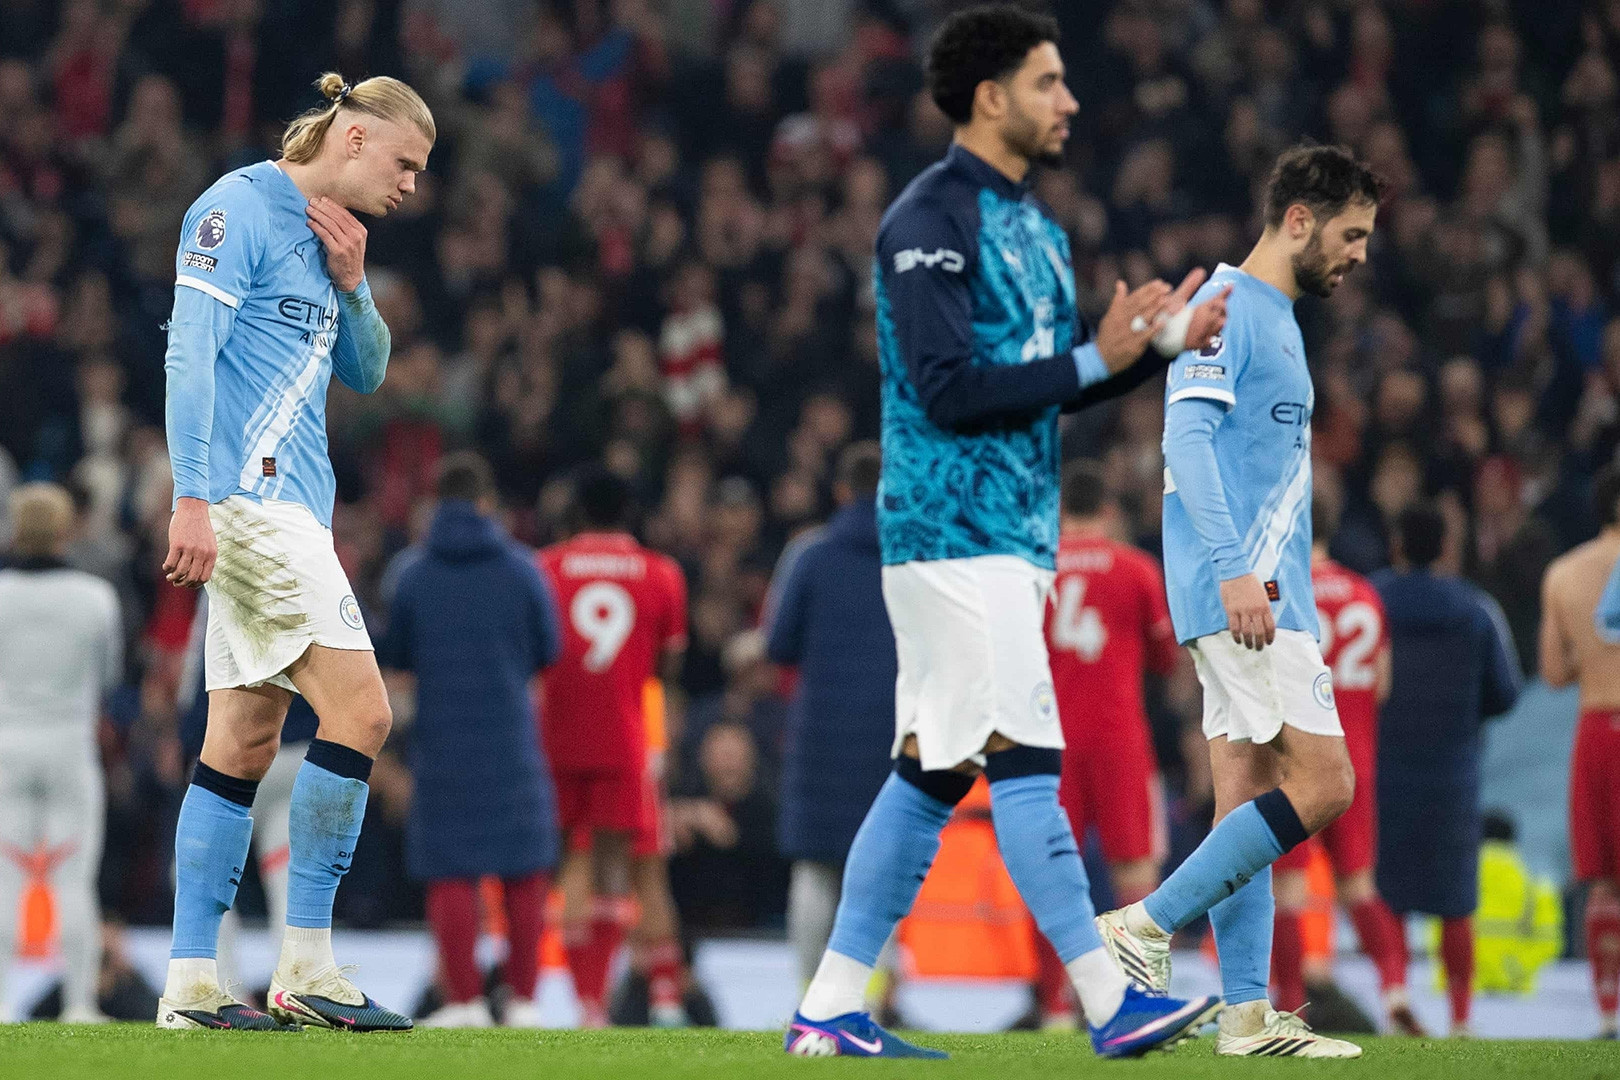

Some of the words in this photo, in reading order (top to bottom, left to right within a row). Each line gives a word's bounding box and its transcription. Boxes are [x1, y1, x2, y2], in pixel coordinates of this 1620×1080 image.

[190, 260, 215, 273] racism
[193, 253, 214, 266] room
[893, 247, 965, 273] BYD
[570, 581, 636, 673] 9
[1051, 574, 1107, 662] 4
